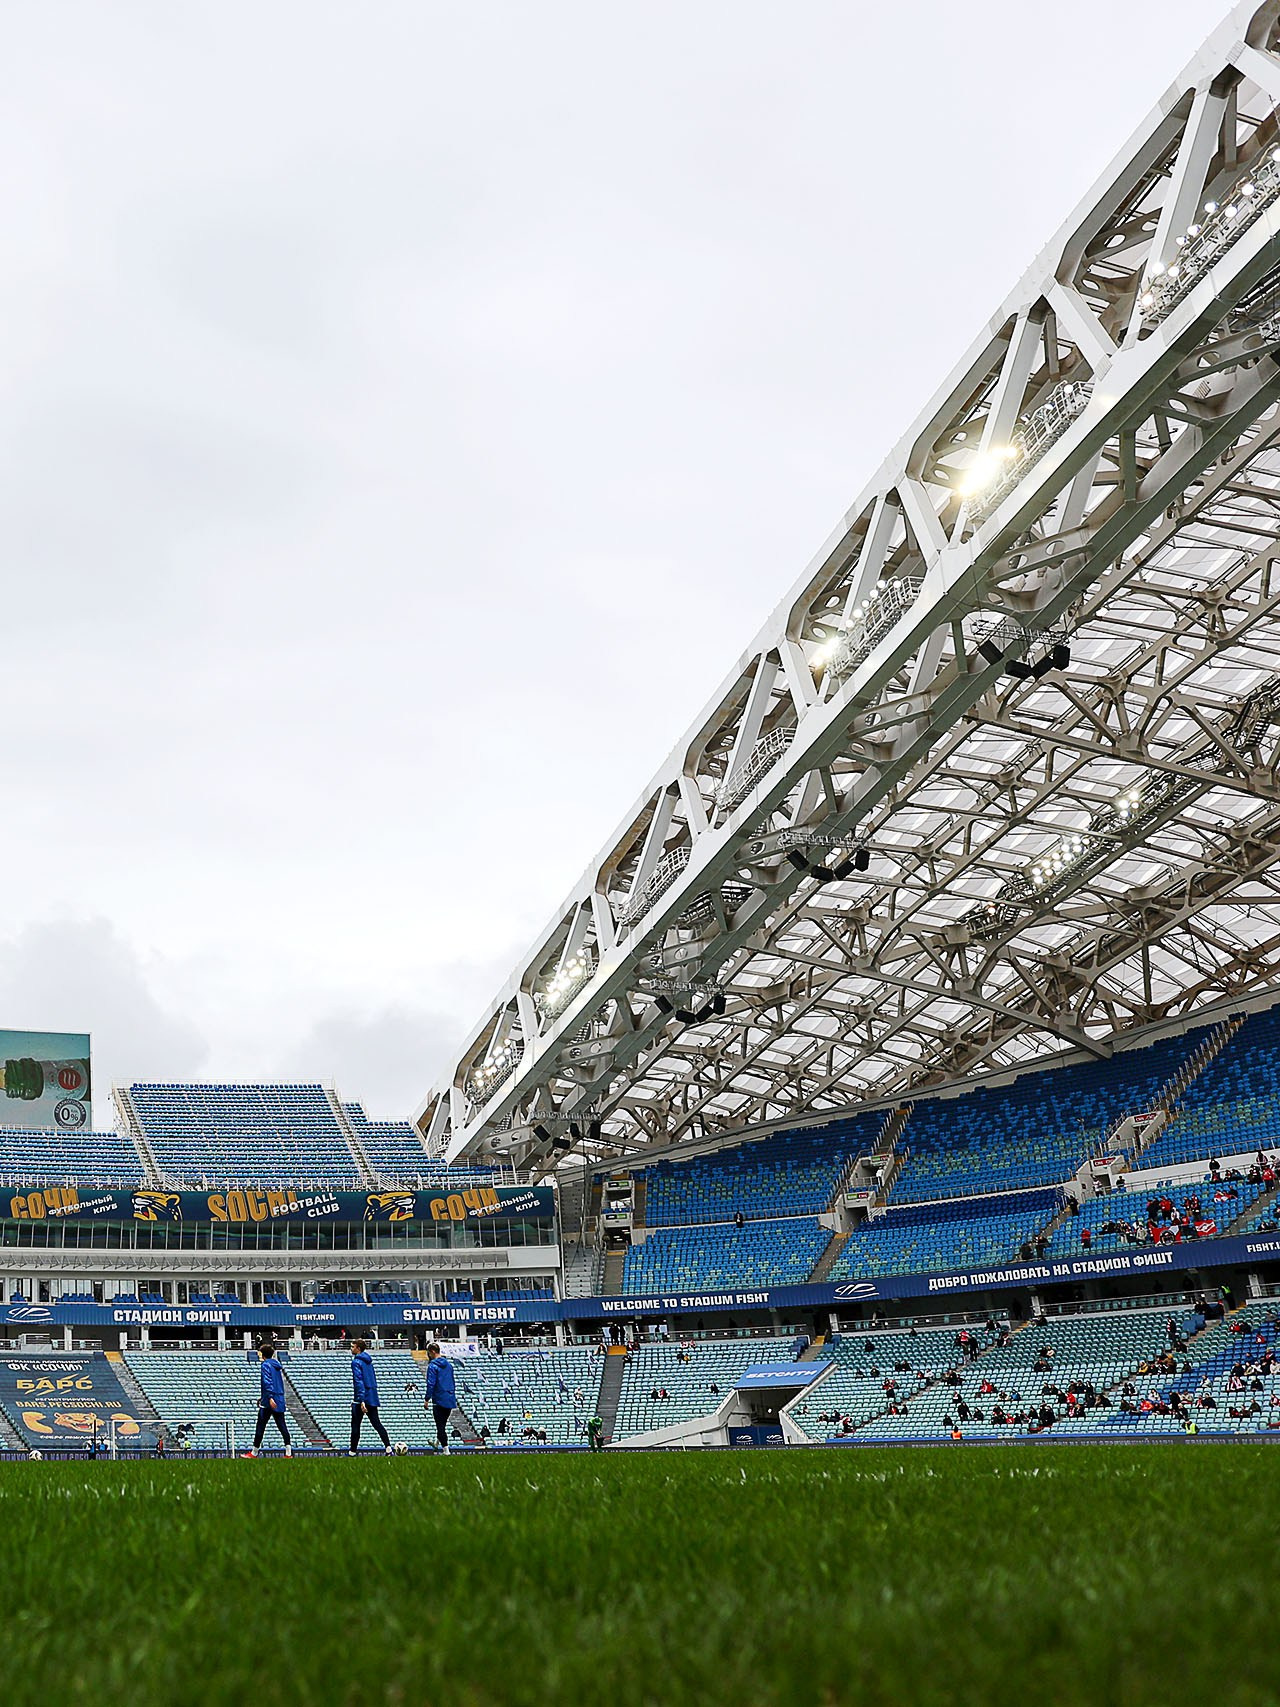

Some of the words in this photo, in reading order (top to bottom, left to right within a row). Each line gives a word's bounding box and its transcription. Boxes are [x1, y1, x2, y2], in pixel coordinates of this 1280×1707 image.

[10, 1188, 81, 1219] СОЧИ
[48, 1194, 113, 1215] ФУТБОЛЬНЫЙ
[93, 1202, 118, 1215] КЛУБ
[272, 1192, 337, 1216] FOOTBALL
[307, 1202, 340, 1218] CLUB
[429, 1188, 502, 1221] СОЧИ
[468, 1191, 535, 1216] ФУТБОЛЬНЫЙ
[515, 1200, 541, 1213] КЛУБ
[928, 1275, 968, 1291] ДОБРО
[969, 1266, 1051, 1285] ПОЖАЛОВАТЬ
[1053, 1264, 1071, 1276] НА
[1072, 1257, 1131, 1274] СТАДИОН
[1132, 1251, 1173, 1267] ФИШТ
[601, 1299, 660, 1311] WELCOME
[662, 1298, 678, 1308] TO
[680, 1295, 734, 1307] STADIUM
[736, 1292, 770, 1304] FISHT
[113, 1309, 182, 1324] СТАДИОН
[186, 1310, 232, 1323] ФИШТ
[295, 1313, 335, 1321] FISHT.INFO
[403, 1308, 470, 1321] STADIUM
[473, 1307, 517, 1320] FISHT
[7, 1363, 31, 1371] ФК
[32, 1363, 83, 1371] «СОЧИ»
[16, 1379, 94, 1390] БАРС
